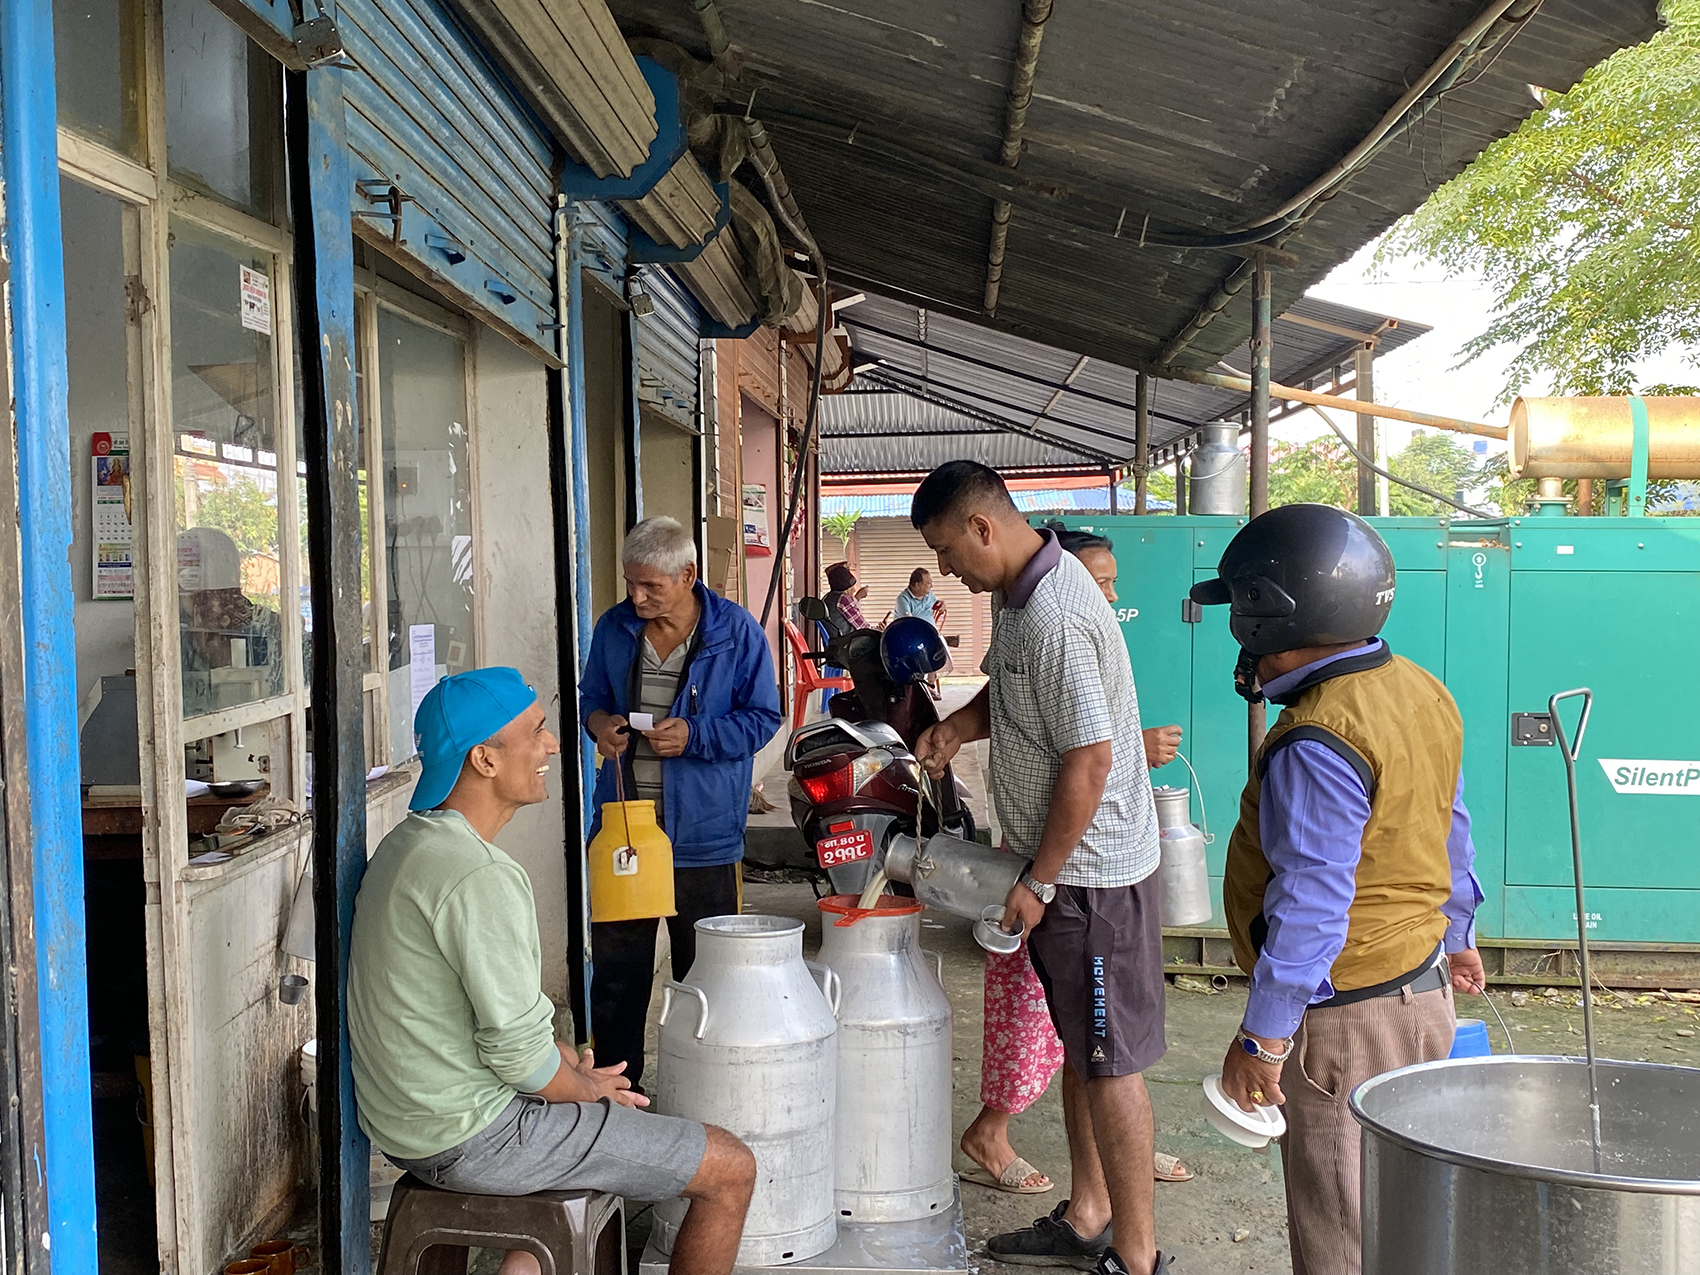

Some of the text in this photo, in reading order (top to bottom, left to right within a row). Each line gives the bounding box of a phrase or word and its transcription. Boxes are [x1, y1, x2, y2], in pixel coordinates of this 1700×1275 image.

[1375, 587, 1395, 605] TVS
[1116, 608, 1139, 622] 5P
[803, 758, 832, 769] HONDA
[1614, 766, 1700, 787] SilentP
[1572, 912, 1590, 920] LE
[1093, 956, 1106, 1038] MOVEMENT
